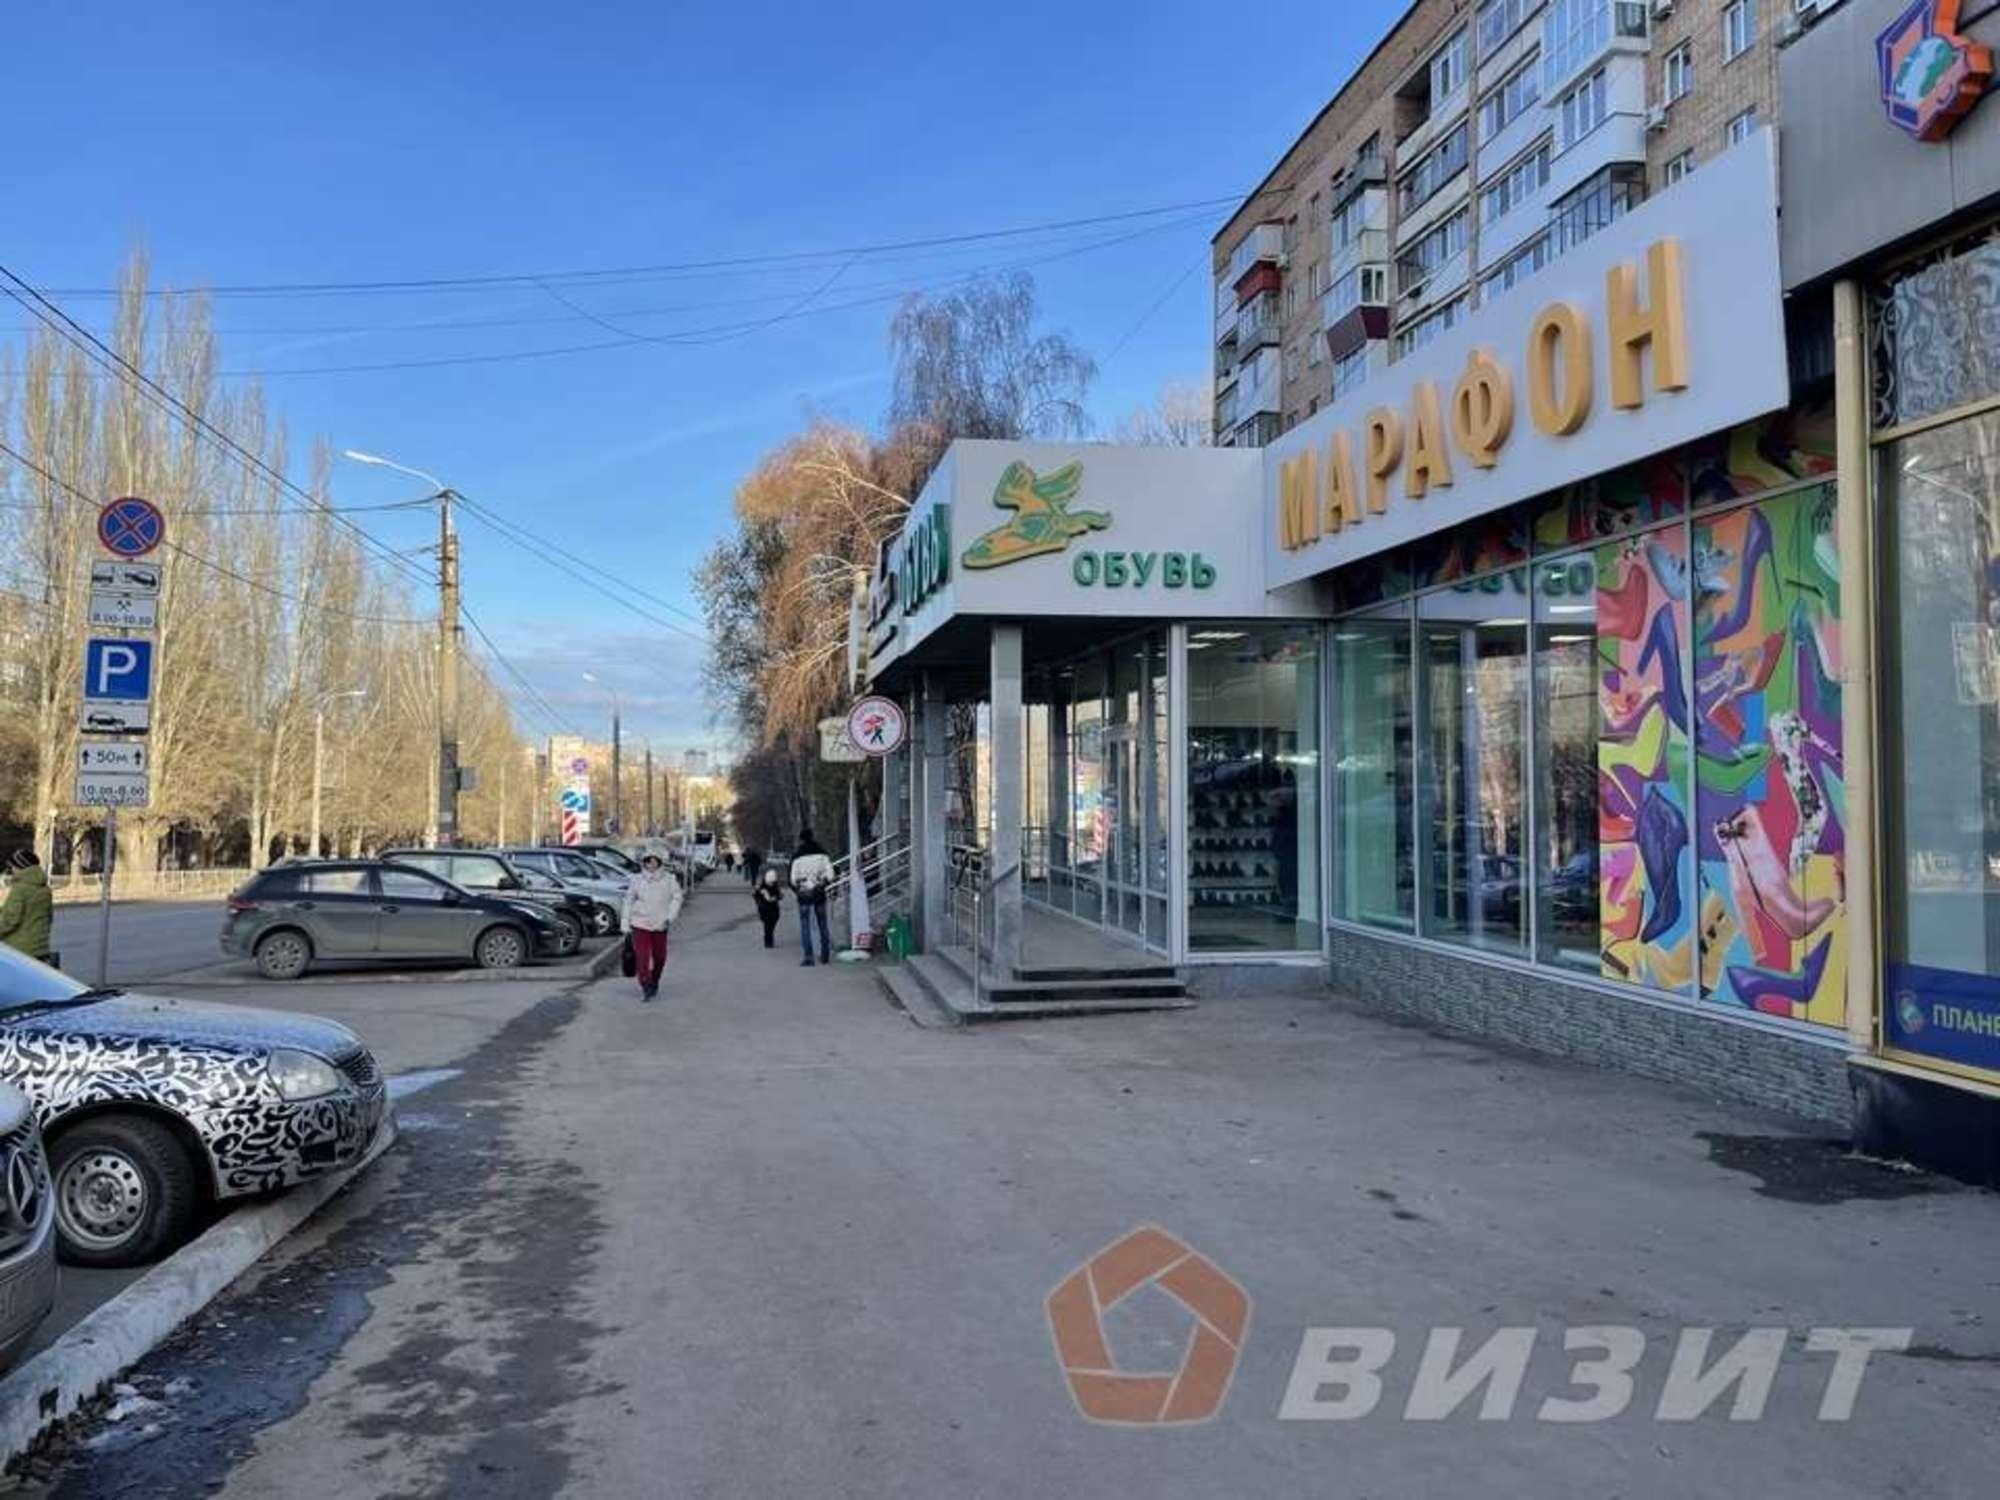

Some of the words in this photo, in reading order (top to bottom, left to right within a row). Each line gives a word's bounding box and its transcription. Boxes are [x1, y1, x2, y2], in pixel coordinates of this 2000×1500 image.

[1280, 236, 1689, 551] МАРАФОН
[1072, 551, 1218, 589] ОБУВЬ
[100, 646, 137, 693] P
